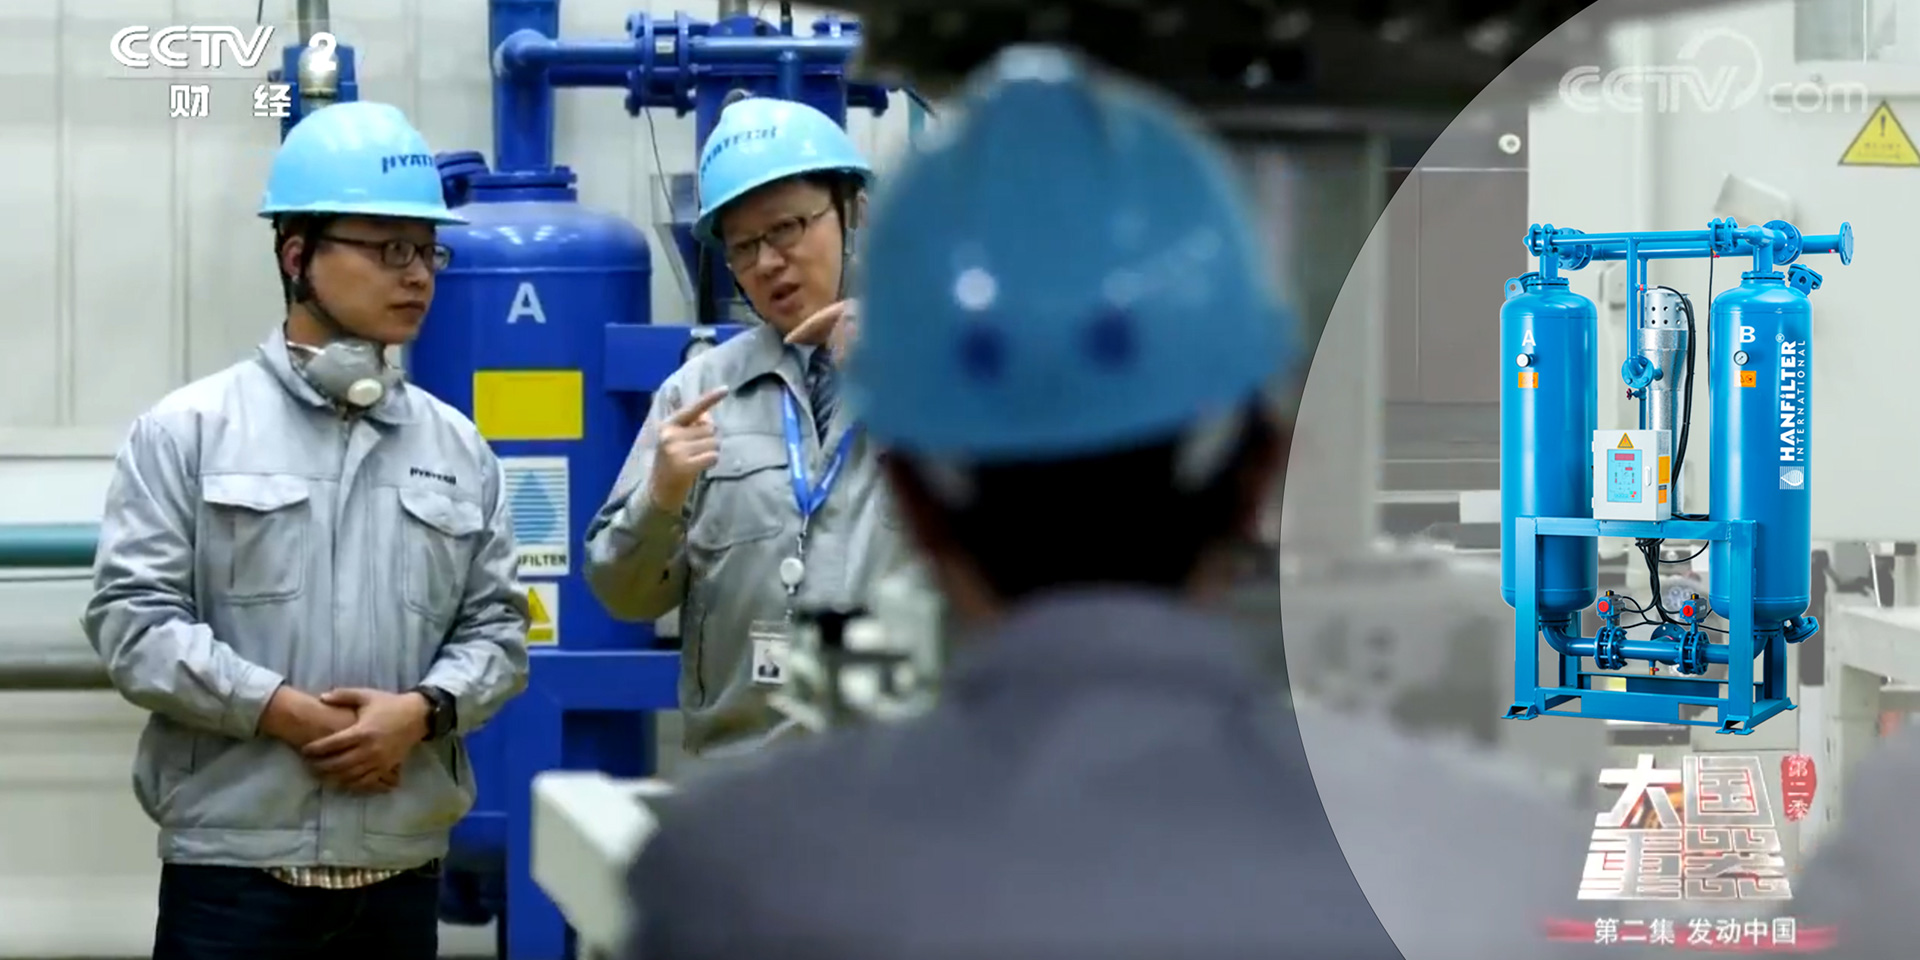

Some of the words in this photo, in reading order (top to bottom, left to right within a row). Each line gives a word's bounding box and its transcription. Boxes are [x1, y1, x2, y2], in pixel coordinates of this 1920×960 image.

[507, 282, 546, 324] A
[1521, 329, 1537, 347] A
[1739, 325, 1756, 344] B
[1796, 340, 1806, 462] INTERNATIONAL
